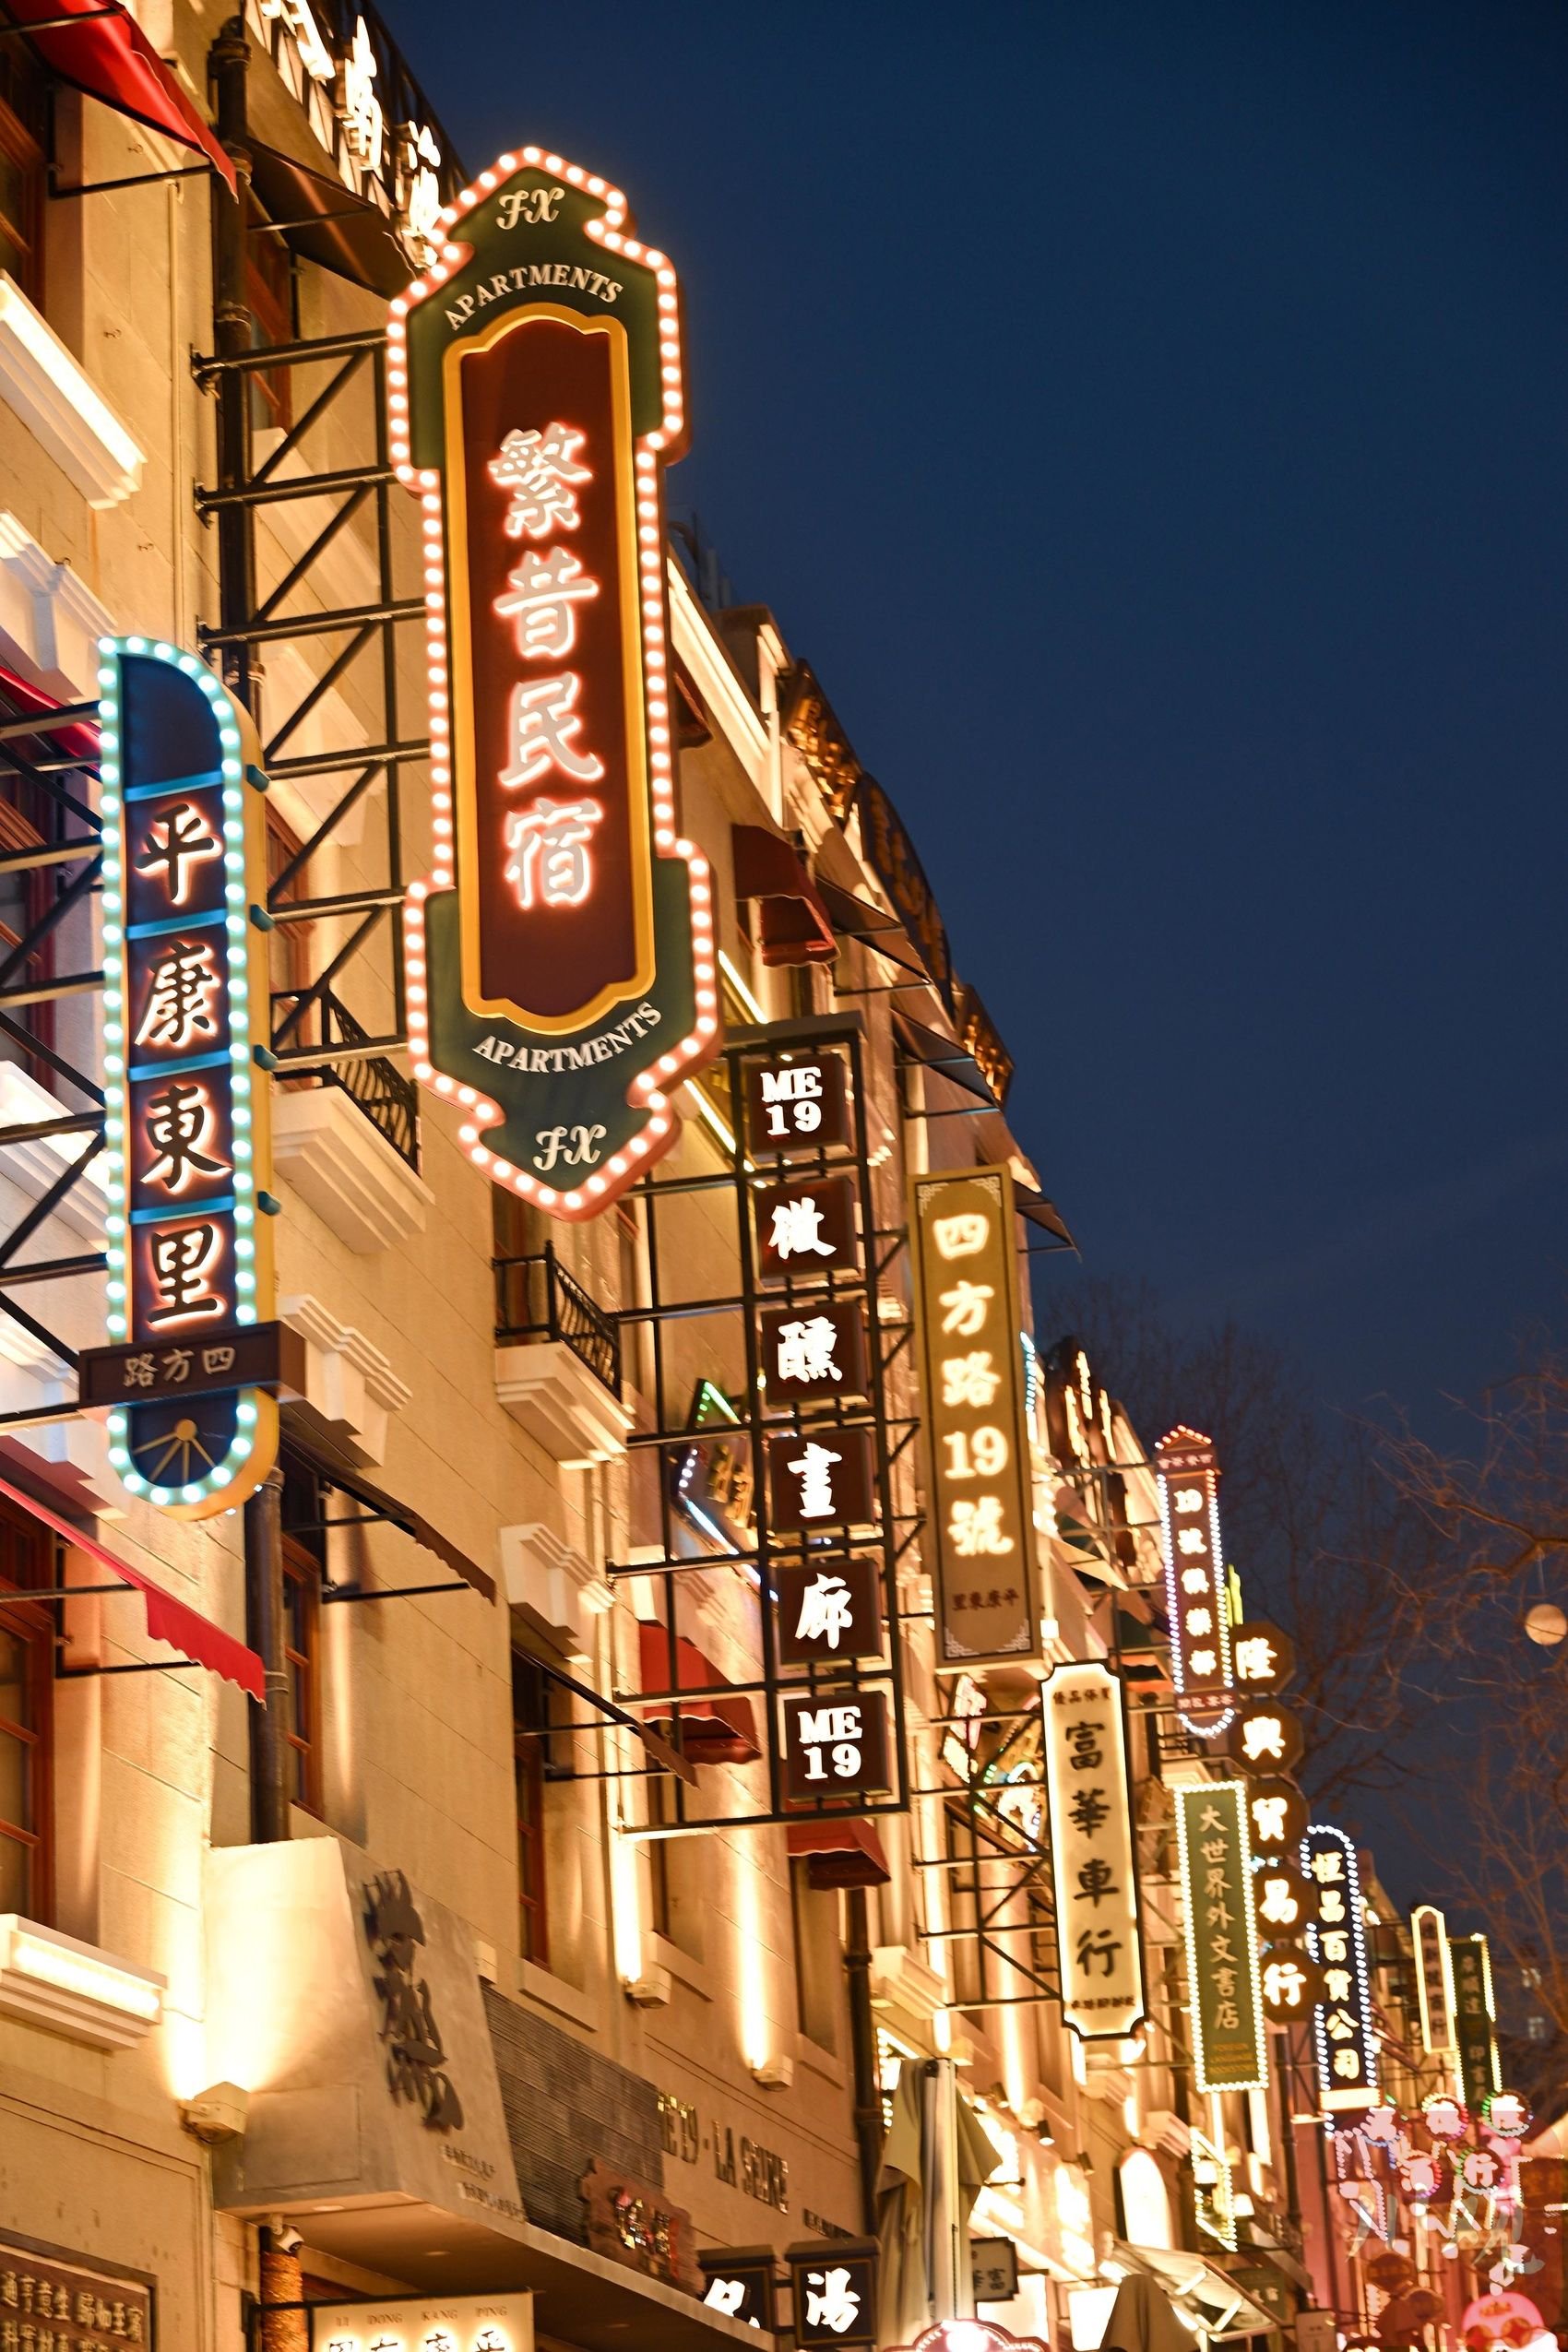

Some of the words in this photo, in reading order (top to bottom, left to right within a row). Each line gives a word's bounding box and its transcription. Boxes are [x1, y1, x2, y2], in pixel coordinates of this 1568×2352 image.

[495, 187, 565, 230] FX
[444, 264, 624, 331] APARTMENTS
[488, 421, 605, 911] 繁昔民宿
[471, 1002, 662, 1074] APARTMENTS
[134, 802, 233, 1329] 平康東里
[760, 1065, 823, 1102] ME
[766, 1104, 822, 1136] 19
[532, 1123, 607, 1171] FX
[798, 1705, 862, 1744] ME
[803, 1743, 861, 1781] 19
[1065, 1721, 1123, 1978] 富華車行
[1198, 1804, 1240, 2030] 大世界外文書店
[366, 2313, 403, 2325] DONG
[421, 2310, 458, 2322] KANG
